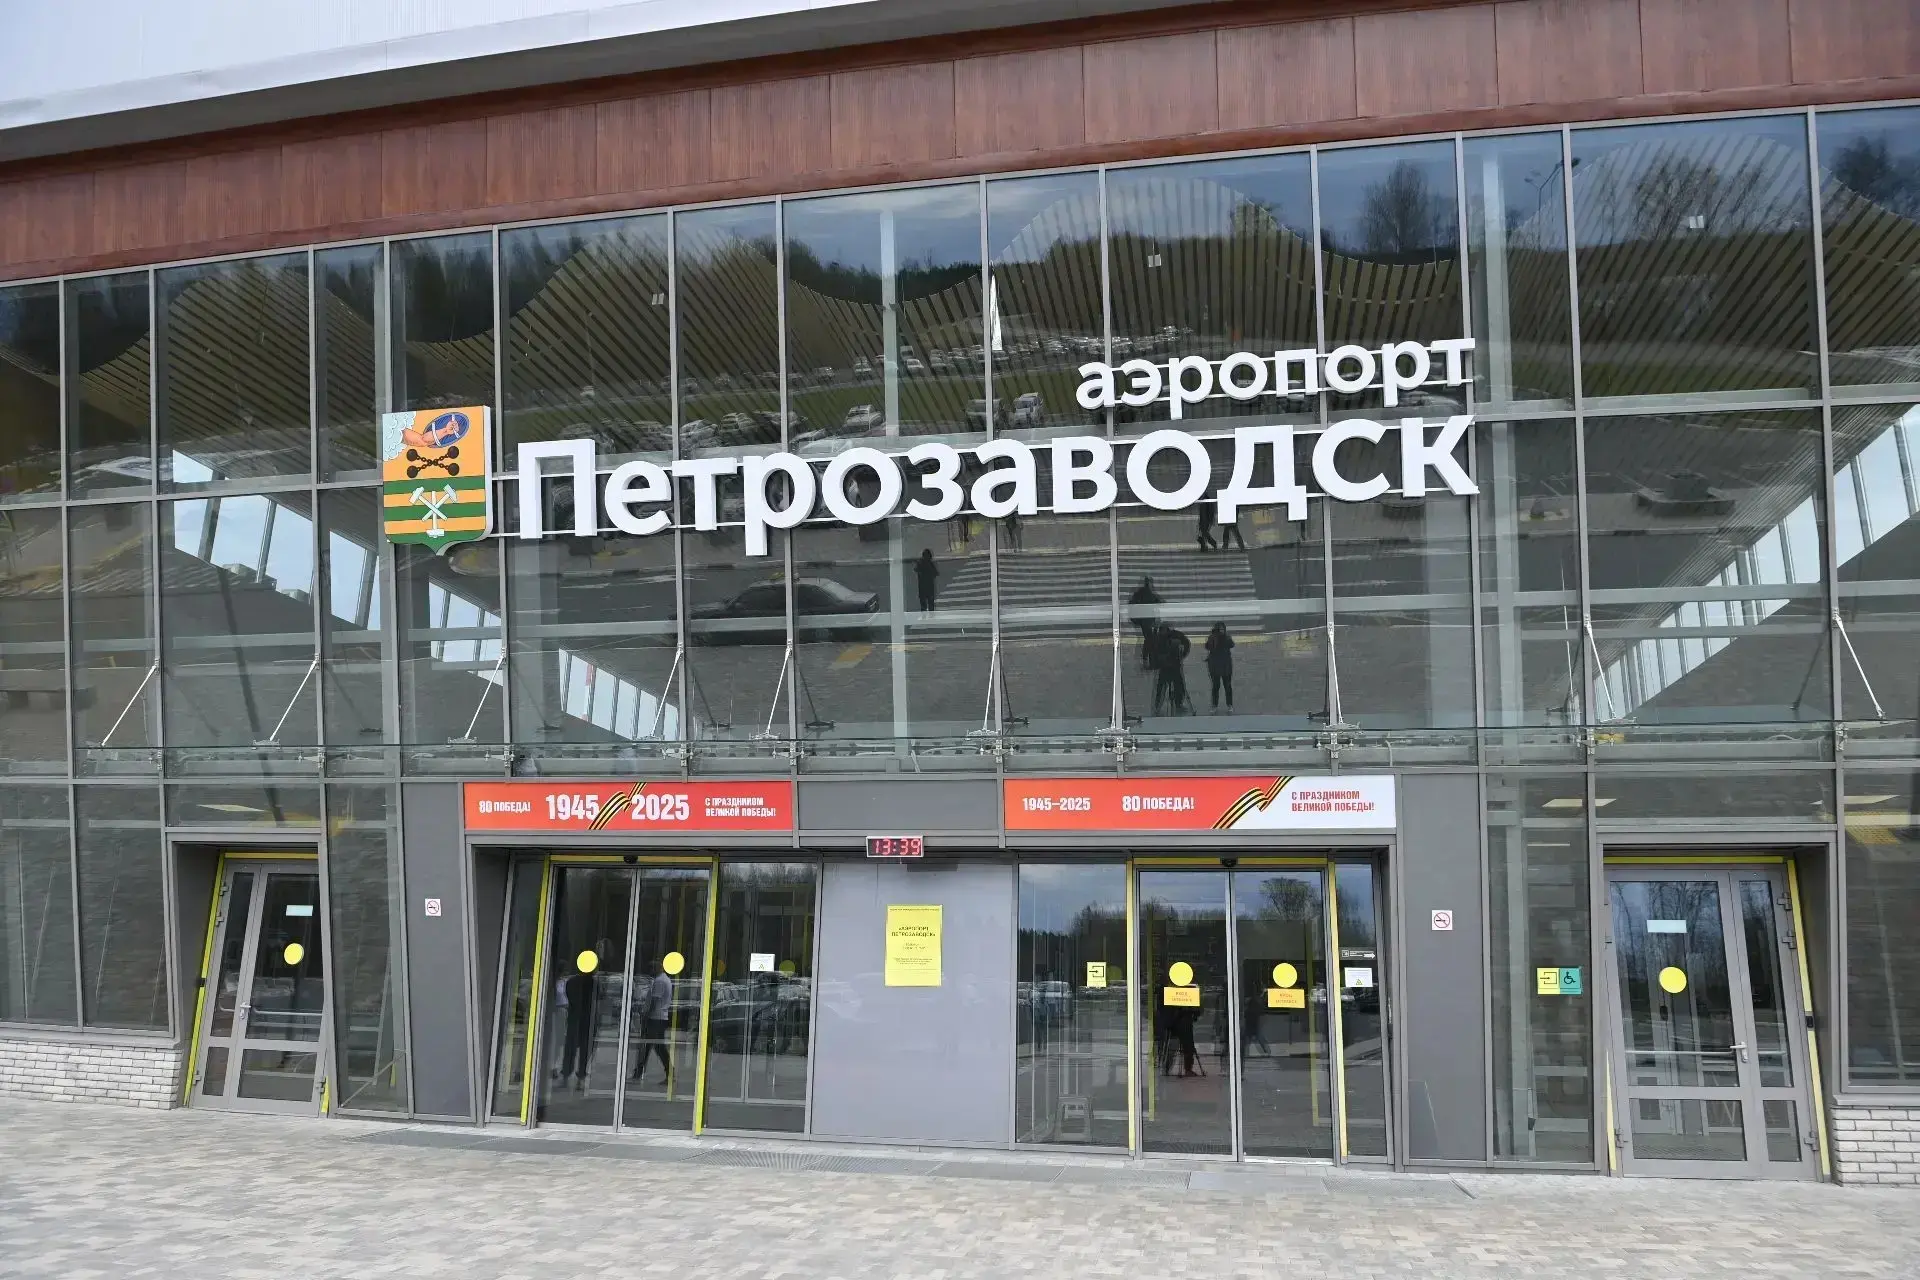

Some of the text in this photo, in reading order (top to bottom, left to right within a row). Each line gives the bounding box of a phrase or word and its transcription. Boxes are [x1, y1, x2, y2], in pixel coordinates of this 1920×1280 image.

[1076, 338, 1476, 420] аэропорт
[517, 414, 1480, 556] Петрозаводск
[705, 797, 764, 807] С ПРАЗДНИКОМ
[1122, 796, 1195, 812] 80 ПОБЕДА!
[1291, 791, 1360, 801] С ПРАЗДНИКОМ
[493, 801, 531, 814] ПОБЕДА!
[546, 794, 600, 821] 1945
[631, 794, 690, 821] 2025
[705, 807, 776, 818] ВЕЛИКОЙ ПОБЕДЫ!
[1291, 802, 1375, 812] ВЕЛИКОЙ ПОБЕДЫ!
[874, 838, 921, 855] 13:39
